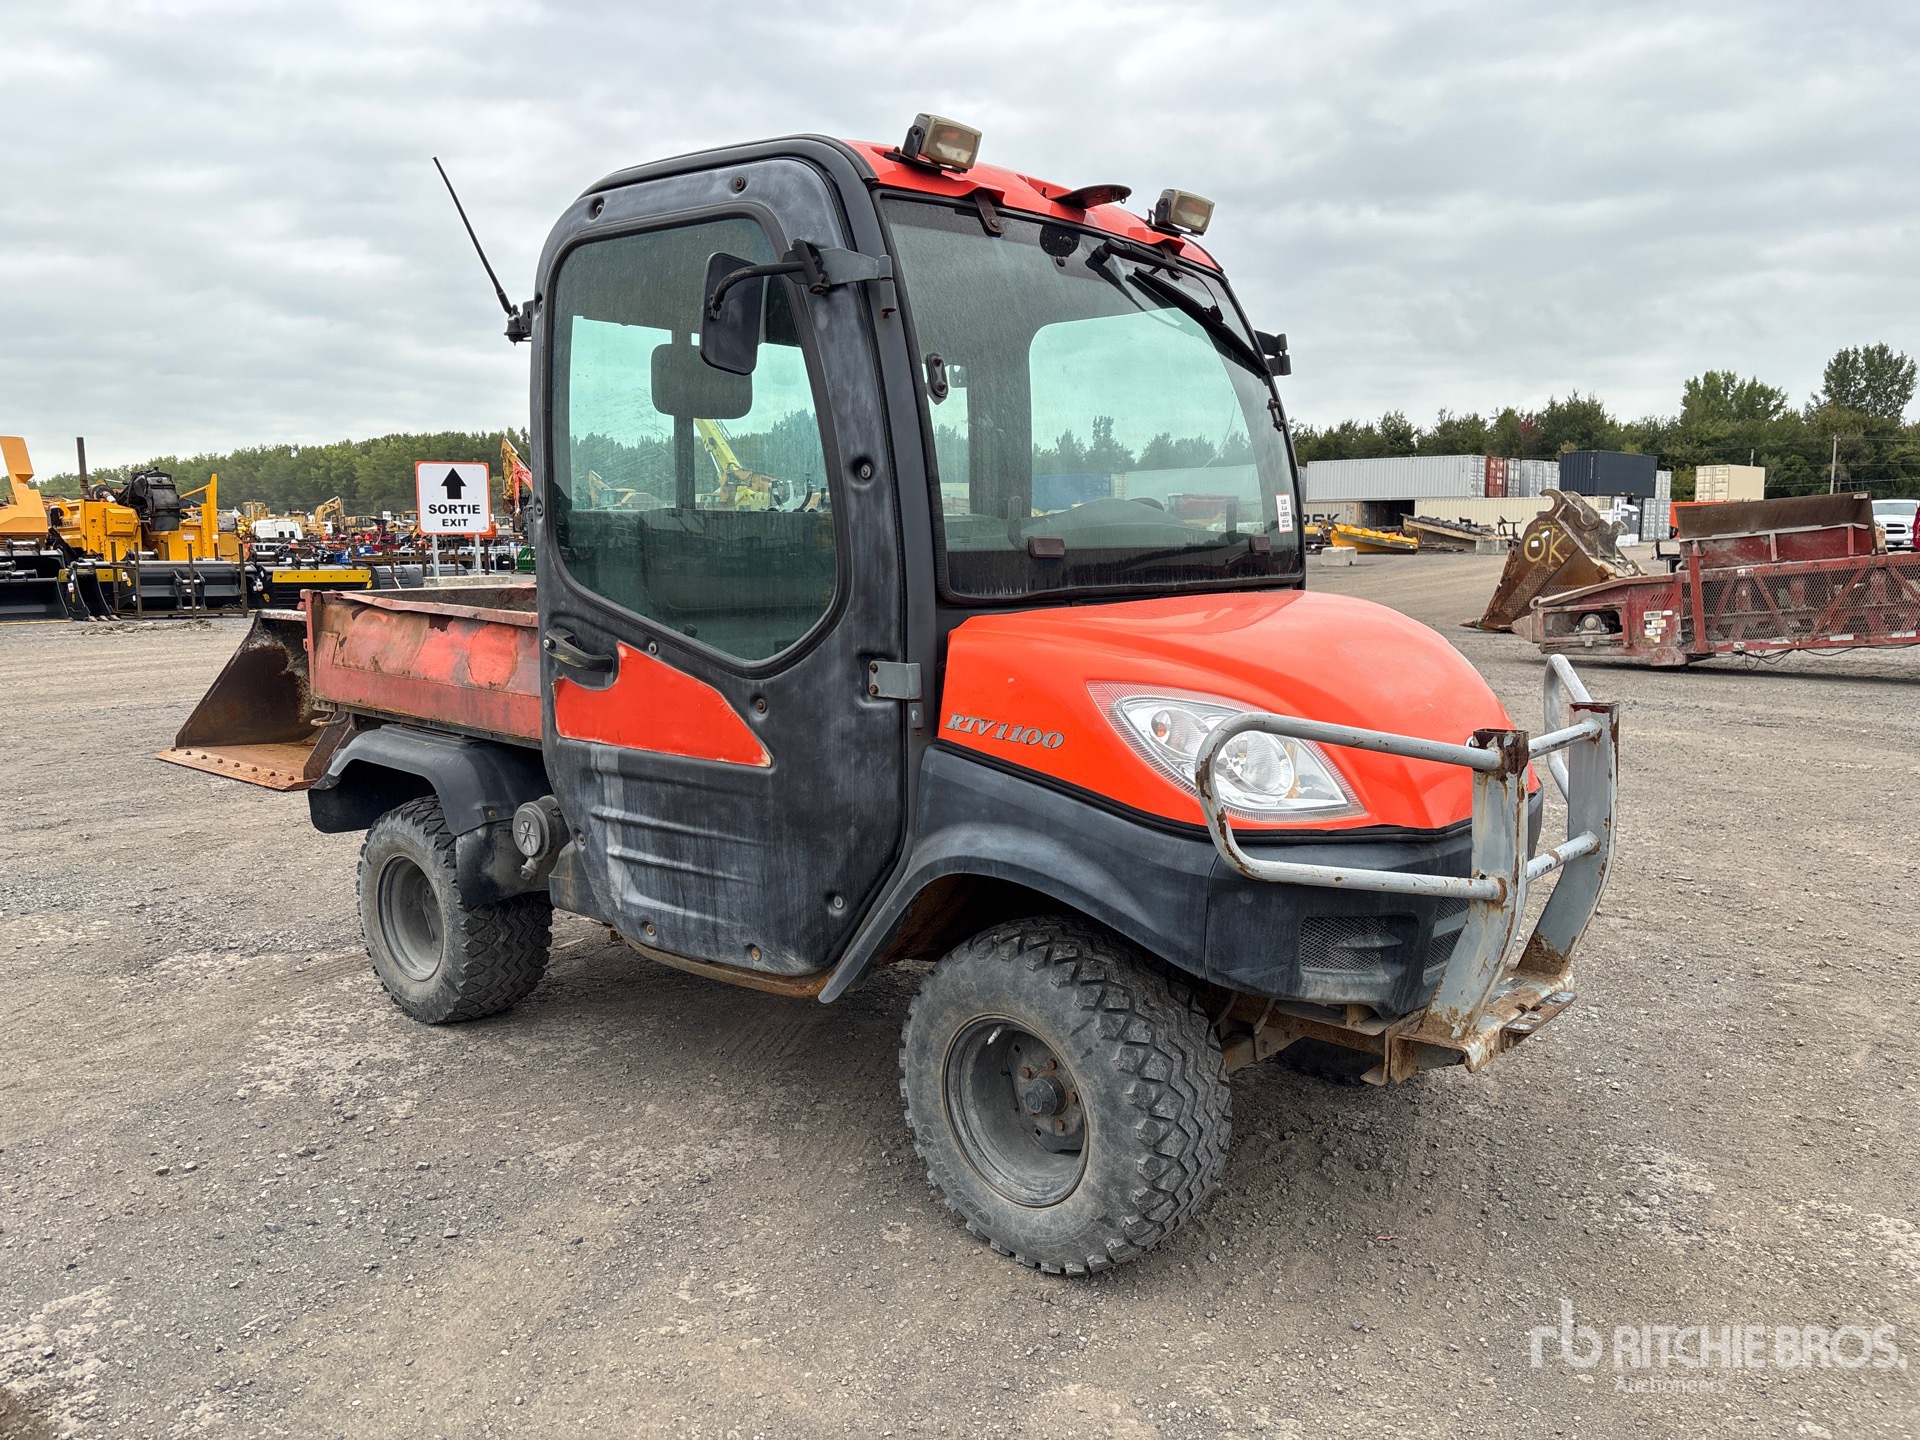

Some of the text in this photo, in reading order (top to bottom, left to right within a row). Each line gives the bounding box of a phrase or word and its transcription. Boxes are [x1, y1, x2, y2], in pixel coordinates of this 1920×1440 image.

[429, 504, 480, 514] SORTIE
[1523, 527, 1567, 565] OK
[945, 712, 1065, 749] RTV1100
